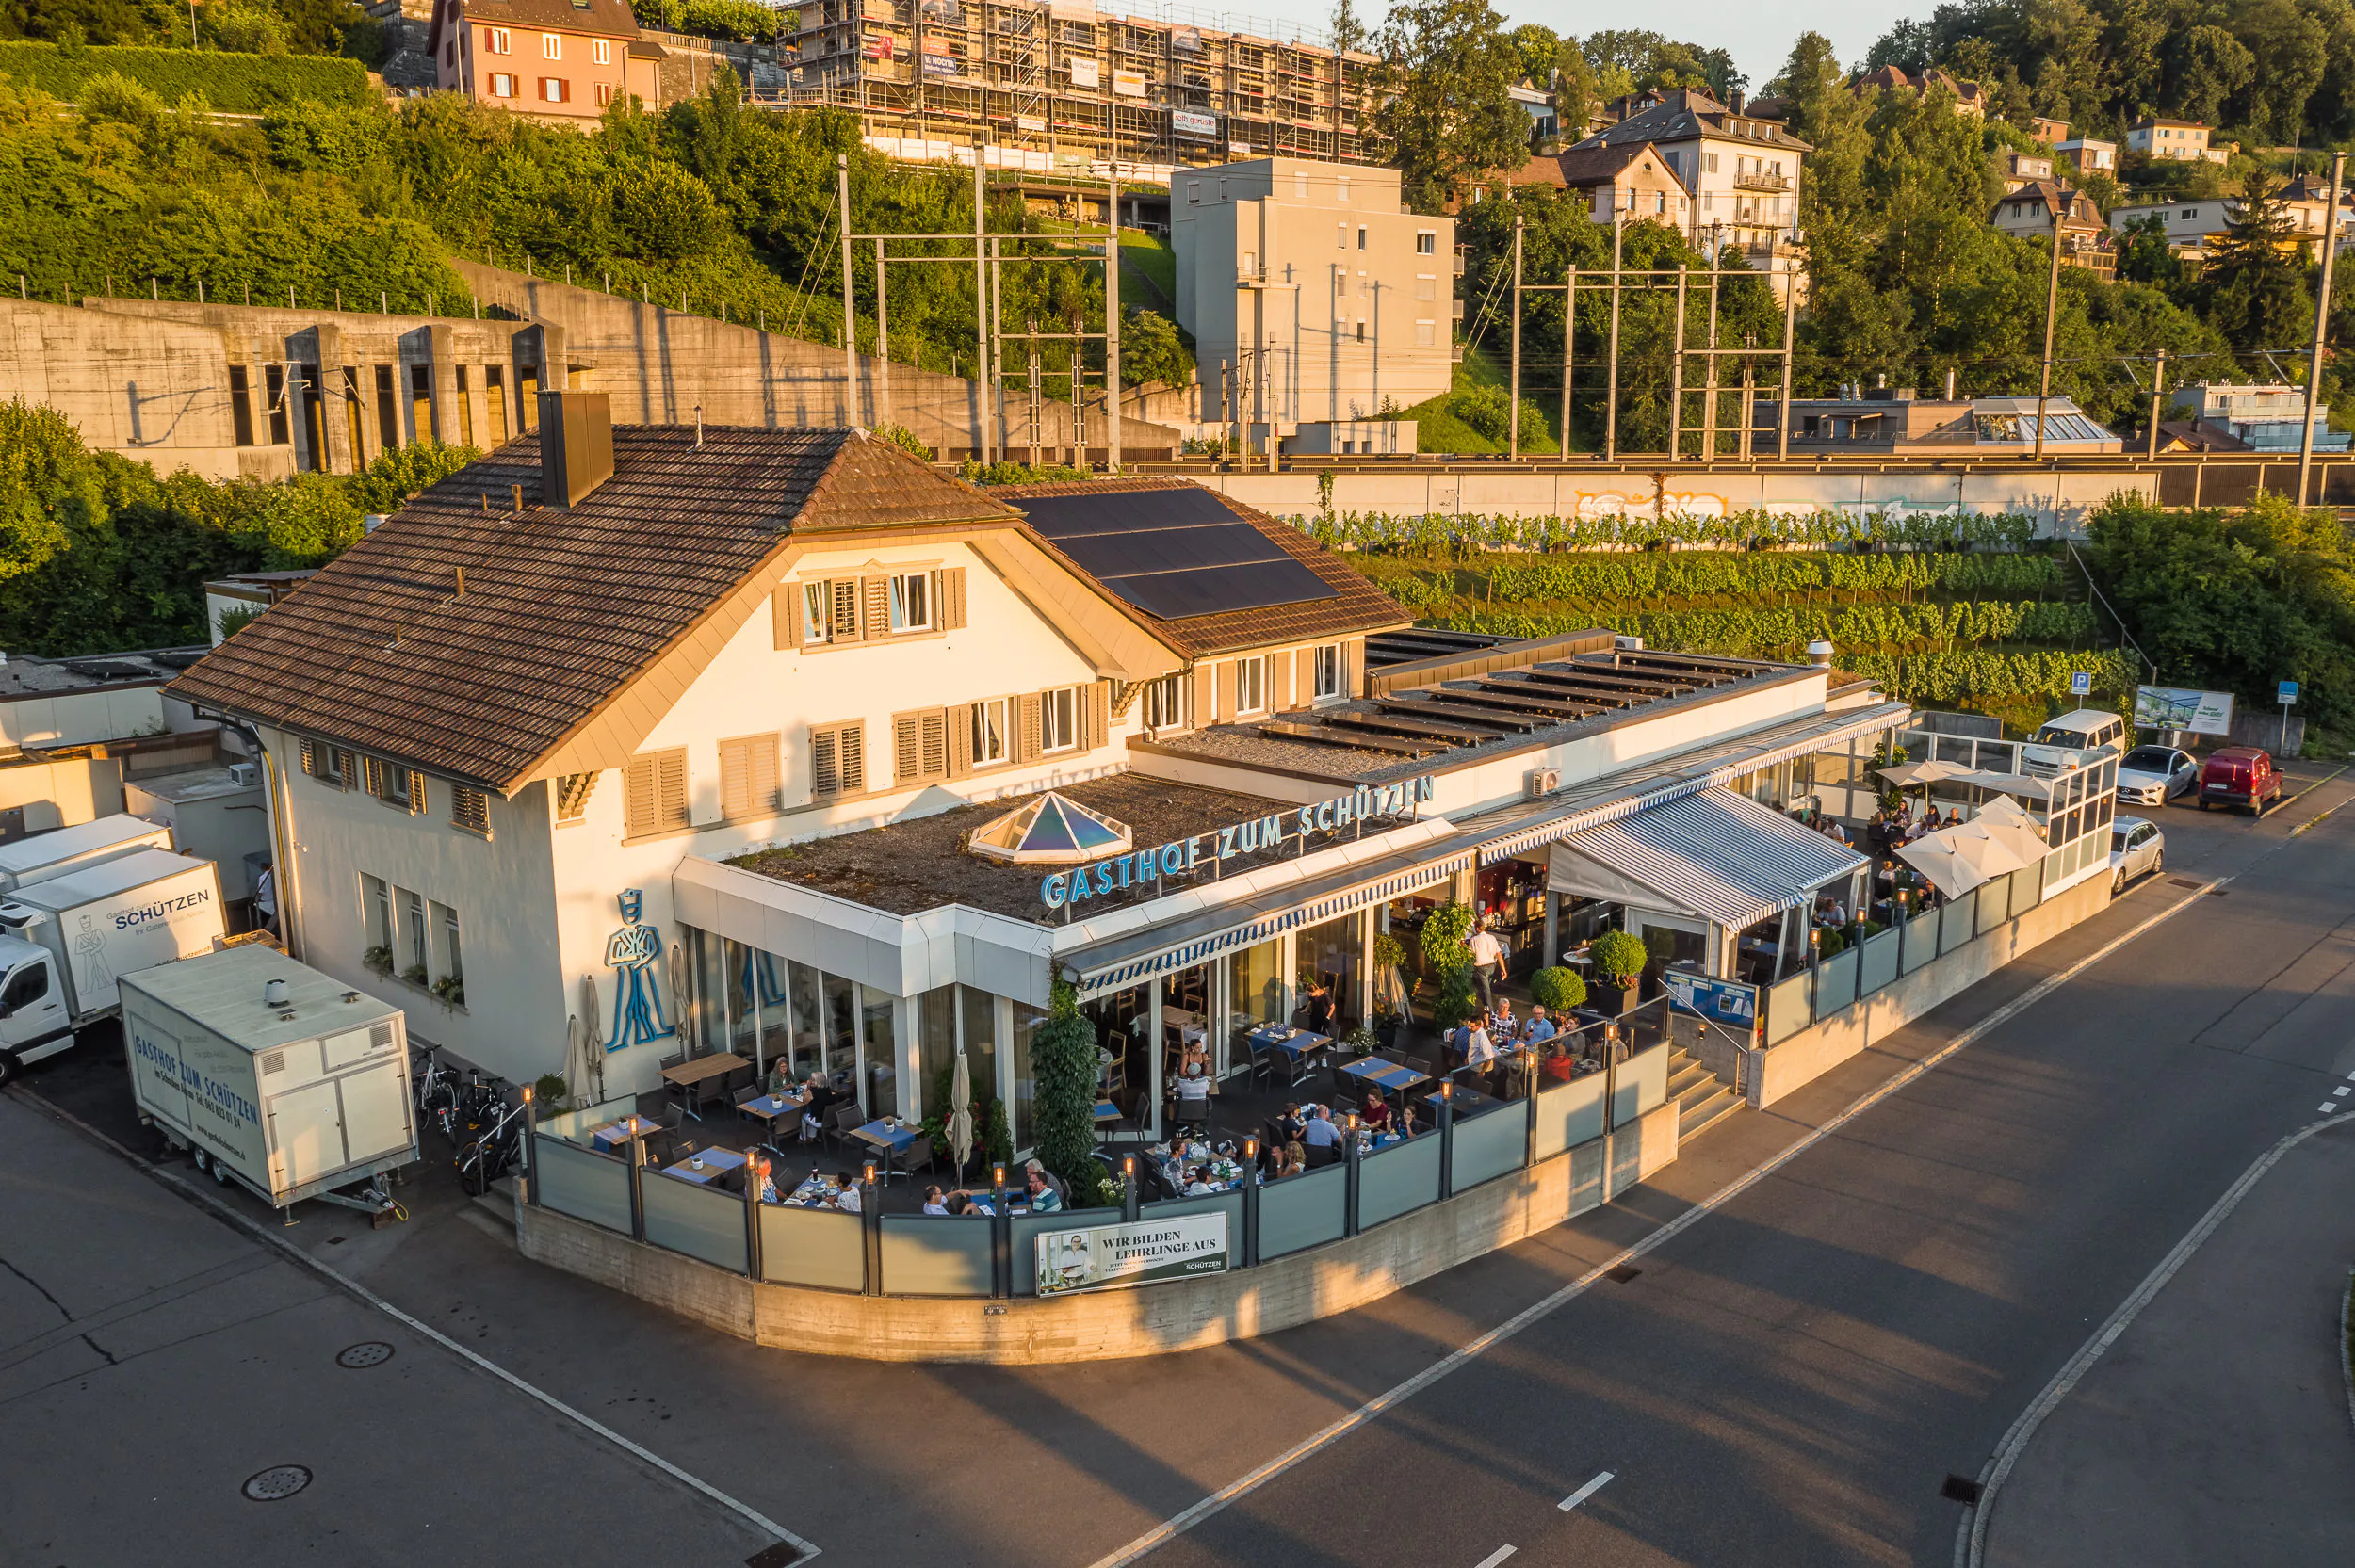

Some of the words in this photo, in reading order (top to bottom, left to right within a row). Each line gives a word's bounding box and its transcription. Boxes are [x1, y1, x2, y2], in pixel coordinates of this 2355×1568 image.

[2077, 675, 2086, 687] P
[1040, 836, 1200, 909] GASTHOF
[1218, 815, 1282, 860] ZUM
[1297, 775, 1434, 836] SCHÜTZEN
[106, 906, 134, 920] Gasthof
[136, 902, 151, 912] zum
[115, 889, 209, 929] SCHÜTZEN
[136, 1035, 176, 1075] GASTHOF
[179, 1061, 202, 1091] ZUM
[204, 1076, 258, 1125] SCHÜTZEN
[1103, 1237, 1129, 1249] WIR
[1133, 1230, 1181, 1245] BILDEN
[1115, 1242, 1190, 1260] LEHRLINGE
[1193, 1239, 1216, 1251] AUS
[1186, 1261, 1221, 1269] SCHÜTZEN
